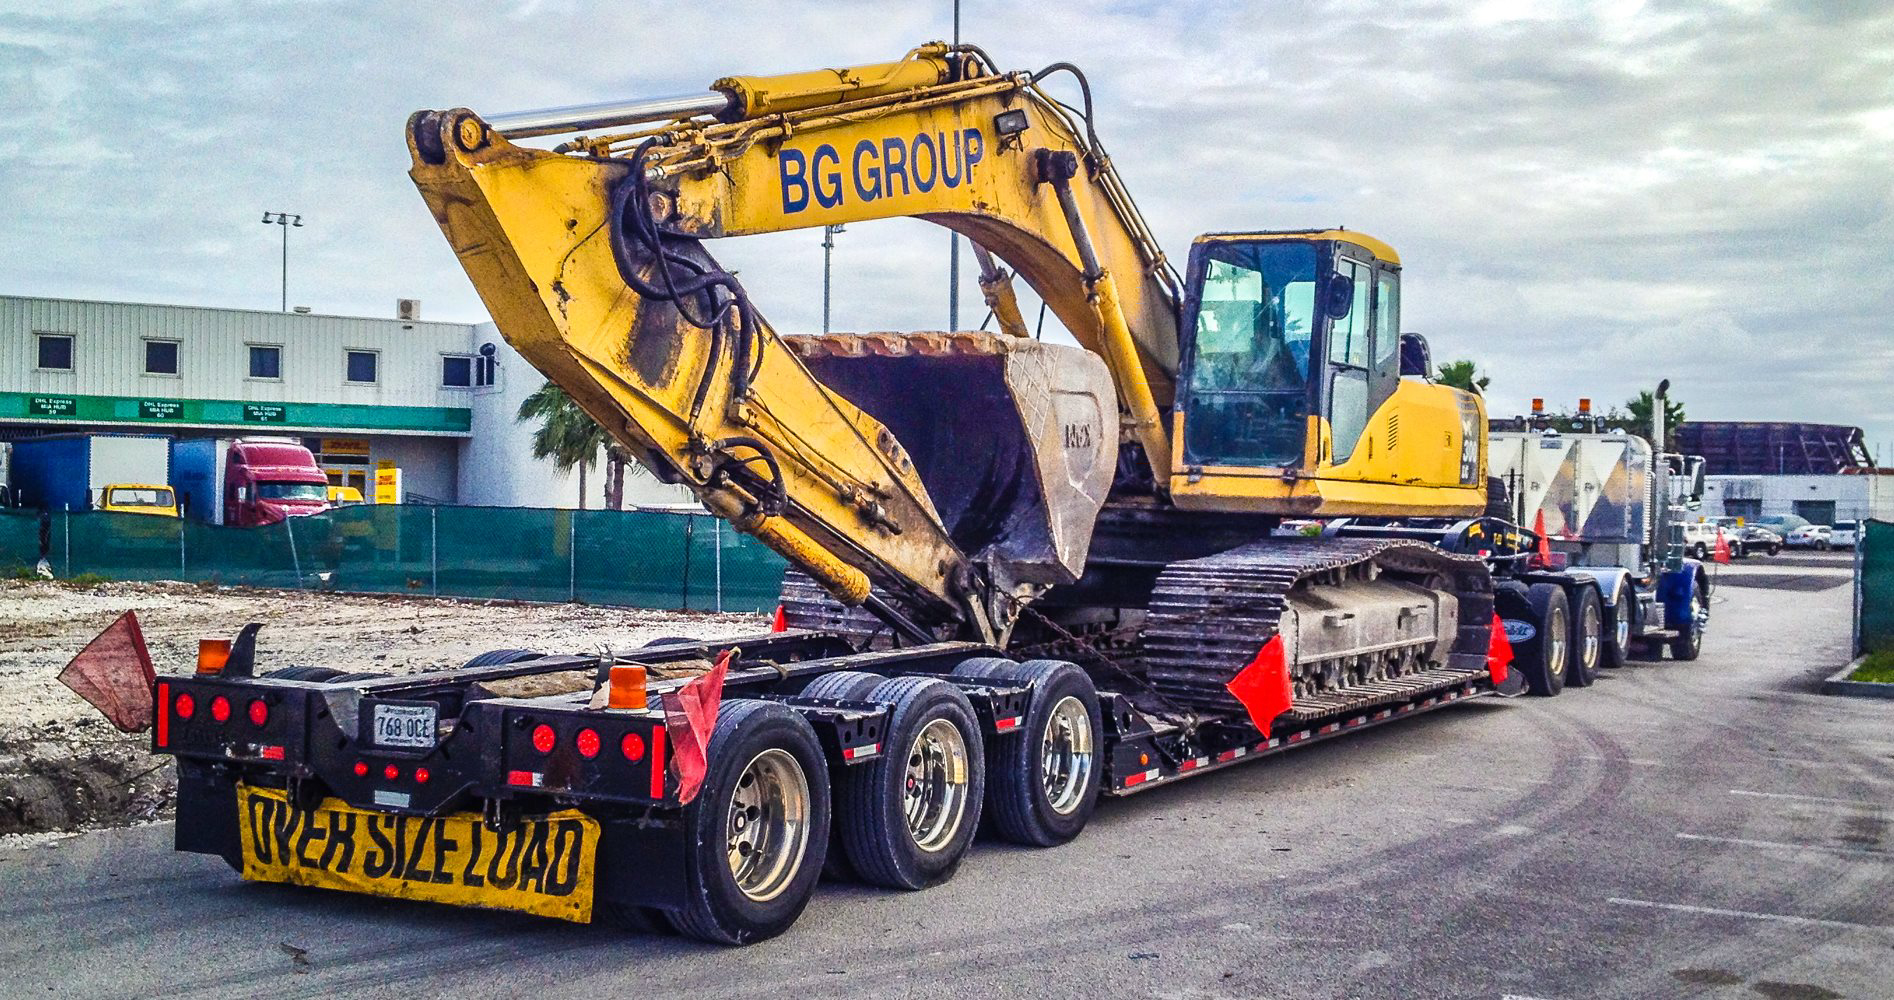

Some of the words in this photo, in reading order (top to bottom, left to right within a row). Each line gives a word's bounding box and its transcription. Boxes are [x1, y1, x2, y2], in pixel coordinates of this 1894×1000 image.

[778, 143, 844, 214] BG
[852, 127, 984, 203] GROUP
[378, 716, 402, 737] 768
[248, 793, 357, 874] OVER
[363, 814, 458, 885] SIZE
[463, 818, 585, 898] LOAD
